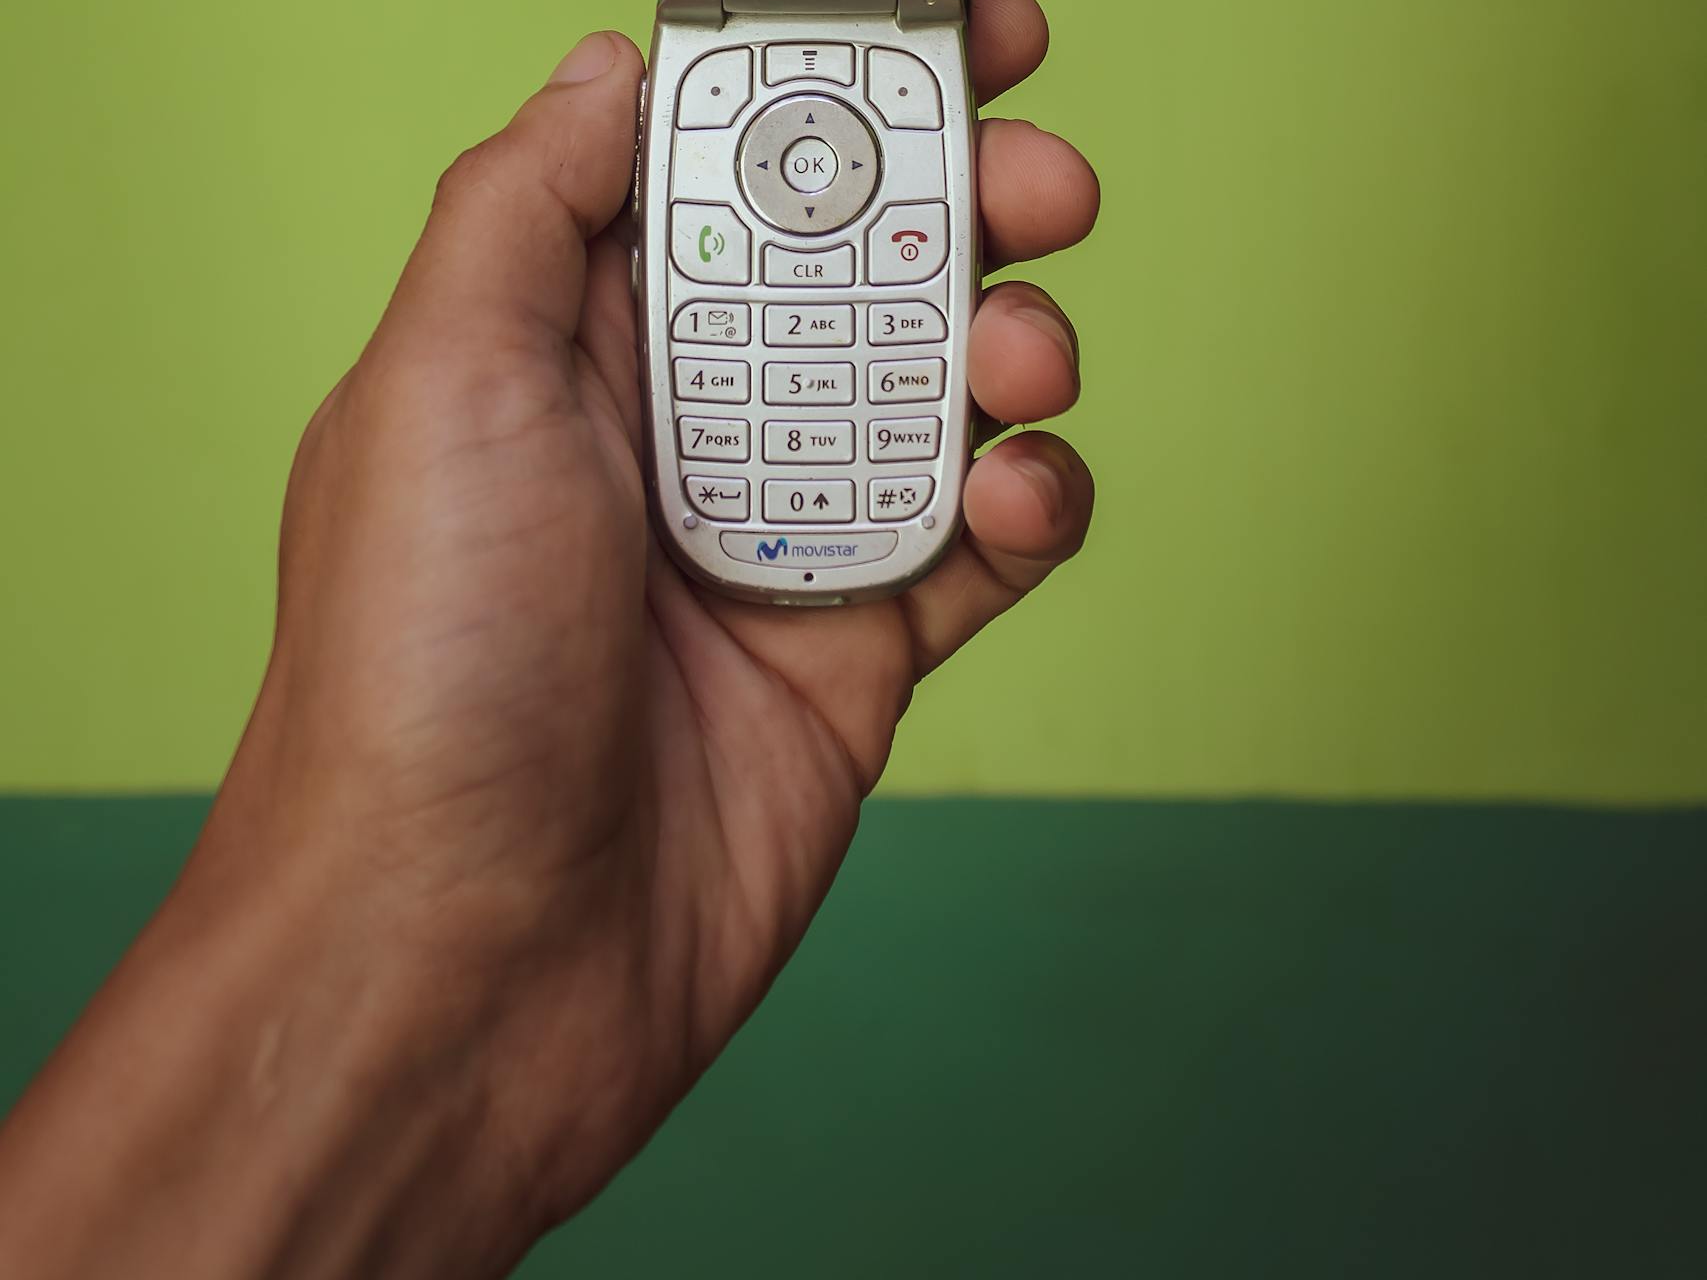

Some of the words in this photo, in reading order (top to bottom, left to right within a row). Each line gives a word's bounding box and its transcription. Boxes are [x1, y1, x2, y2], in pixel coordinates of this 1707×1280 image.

[794, 156, 824, 174] OK
[794, 264, 823, 278] CLR
[689, 312, 698, 332] 1
[788, 315, 801, 335] 2
[810, 320, 836, 330] ABC
[883, 315, 895, 334] 3
[901, 319, 924, 329] DEF
[690, 370, 704, 390] 4
[711, 377, 734, 386] GHI
[789, 374, 801, 394] 5
[816, 380, 837, 390] JKL
[881, 372, 894, 392] 6
[899, 375, 929, 386] MNO
[691, 428, 705, 449] 7
[706, 435, 739, 446] PQRS
[787, 431, 801, 451] 8
[810, 436, 836, 446] TUV
[878, 429, 892, 449] 9
[894, 433, 930, 444] WXYZ
[791, 492, 804, 511] 0
[792, 545, 858, 558] movistar
